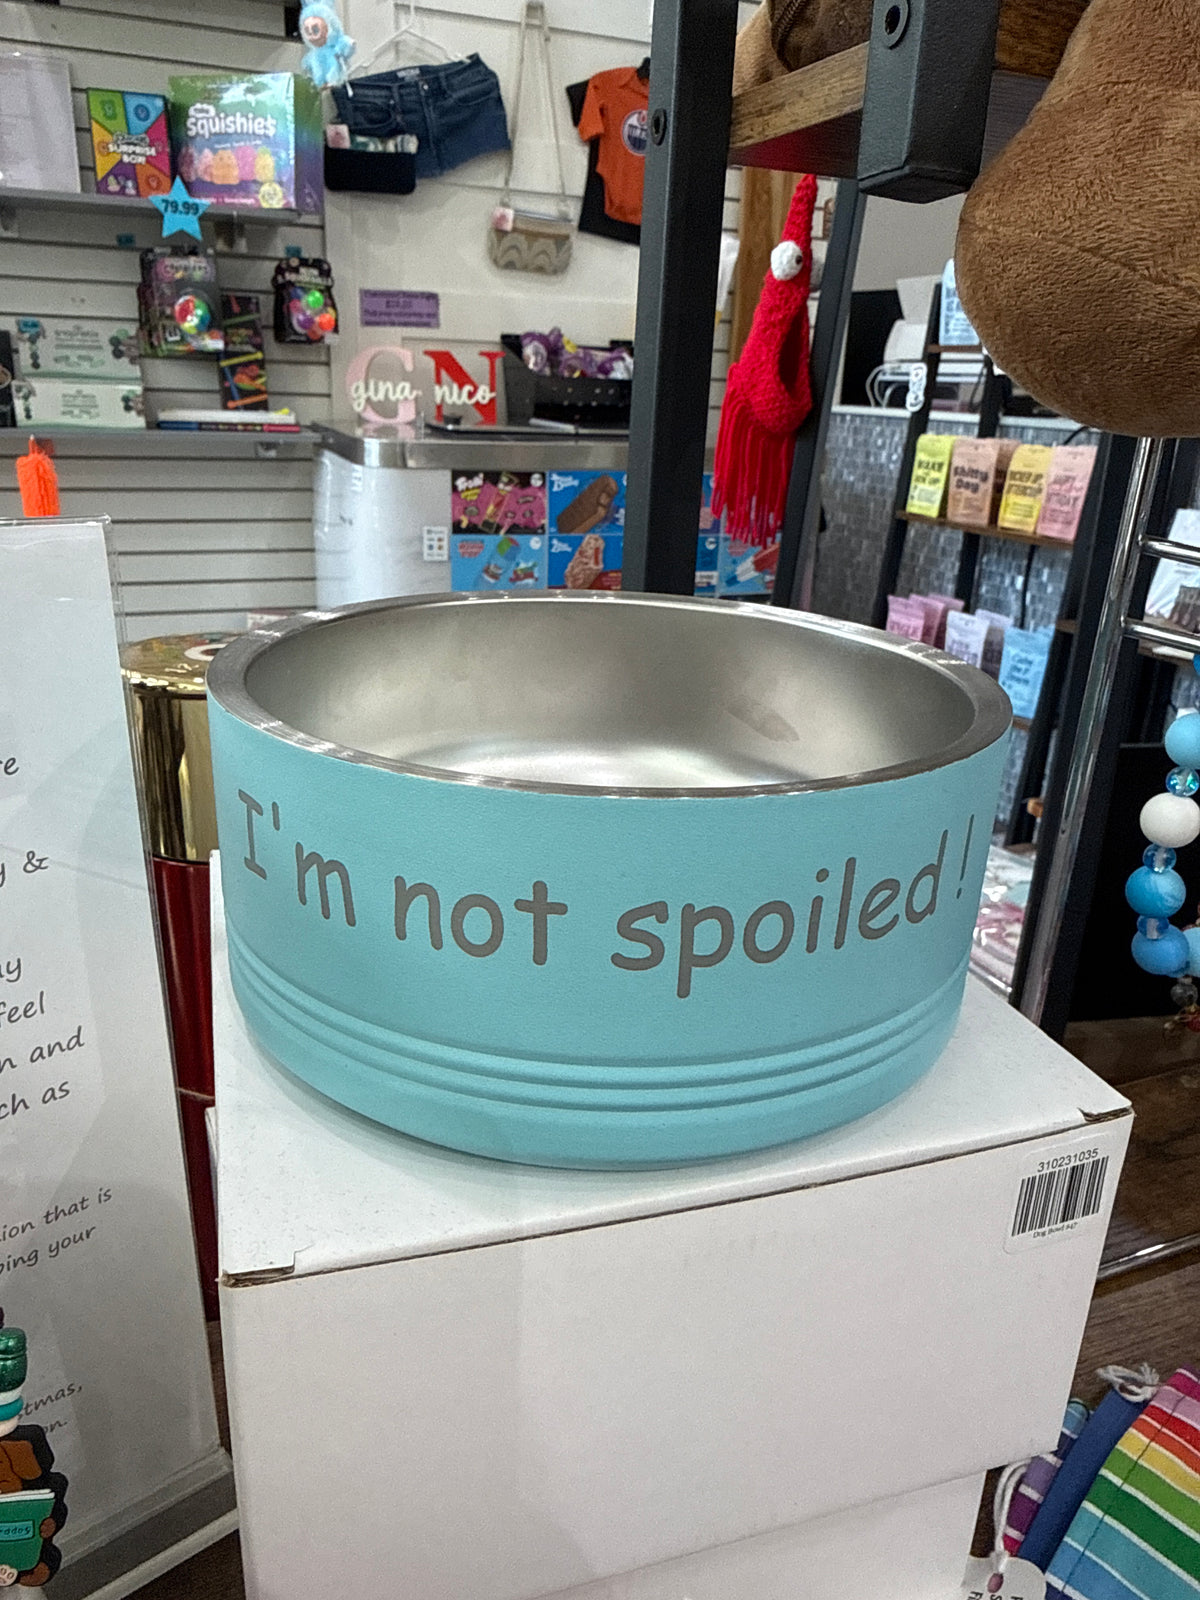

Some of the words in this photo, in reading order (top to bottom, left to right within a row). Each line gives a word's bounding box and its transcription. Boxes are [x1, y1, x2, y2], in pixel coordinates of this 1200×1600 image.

[186, 112, 277, 138] squishies
[161, 198, 200, 216] 79.99
[351, 379, 422, 411] gina
[434, 383, 496, 405] nico
[238, 788, 357, 927] I'm
[394, 875, 569, 966] not
[610, 814, 975, 999] spoiled!
[30, 1025, 85, 1063] and
[42, 1081, 70, 1104] as
[1037, 1148, 1099, 1173] 310231035
[0, 1221, 35, 1242] ion
[43, 1196, 89, 1224] that
[98, 1187, 112, 1204] is
[48, 1226, 96, 1258] your
